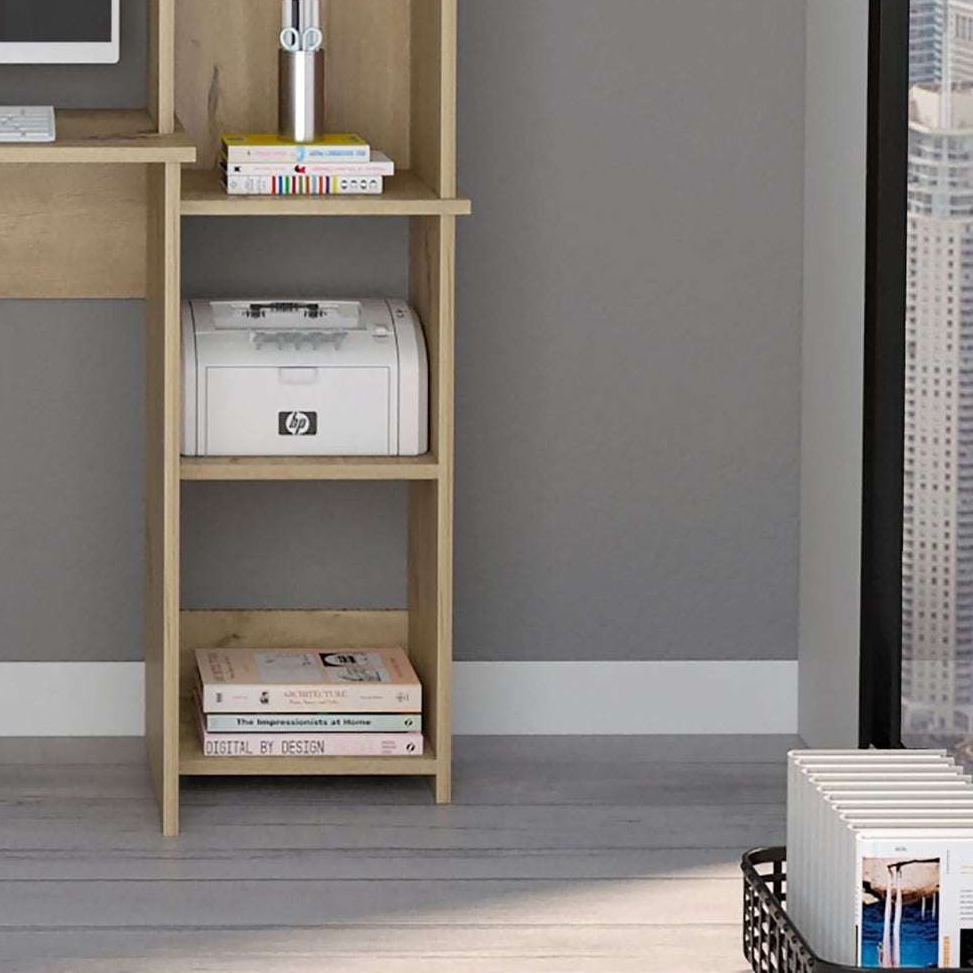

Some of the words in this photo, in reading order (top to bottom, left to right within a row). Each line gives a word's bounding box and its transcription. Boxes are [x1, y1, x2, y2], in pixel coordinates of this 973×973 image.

[236, 718, 254, 726] The
[256, 718, 328, 727] Impressionists
[331, 718, 341, 726] at
[343, 718, 372, 726] Home
[205, 740, 253, 754] DIGITAL
[260, 740, 274, 754] BY
[281, 740, 325, 754] DESIGN
